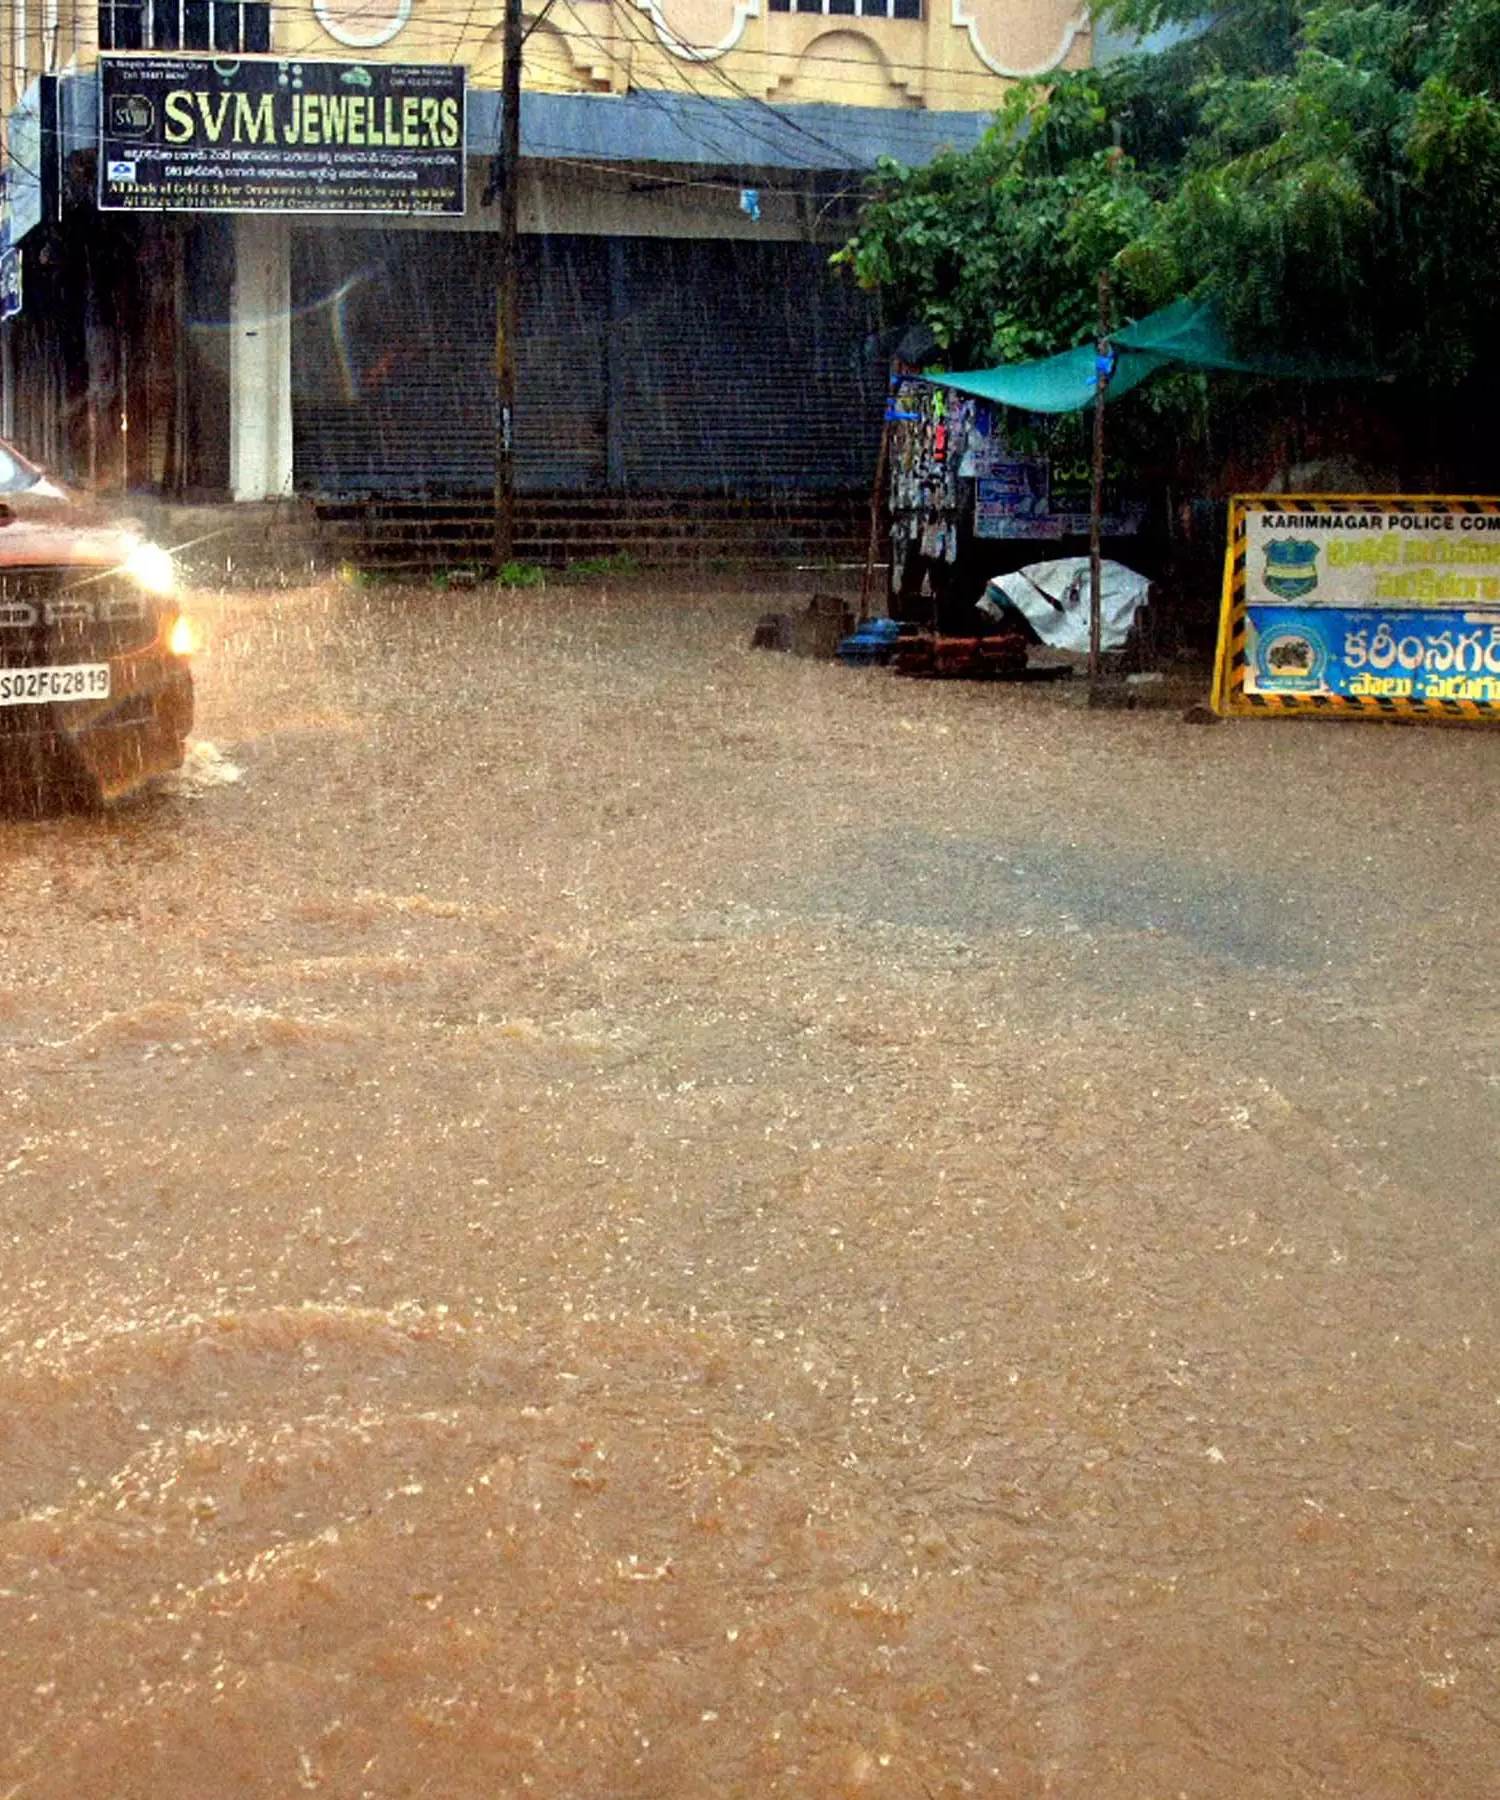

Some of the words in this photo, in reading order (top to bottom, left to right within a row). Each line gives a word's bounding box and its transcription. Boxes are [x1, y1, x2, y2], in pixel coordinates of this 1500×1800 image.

[164, 89, 277, 143] SVM
[283, 94, 459, 147] JEWELLERS
[1261, 514, 1383, 531] KARIMNAGAR
[1388, 515, 1454, 531] POLICE
[1460, 516, 1500, 531] COM
